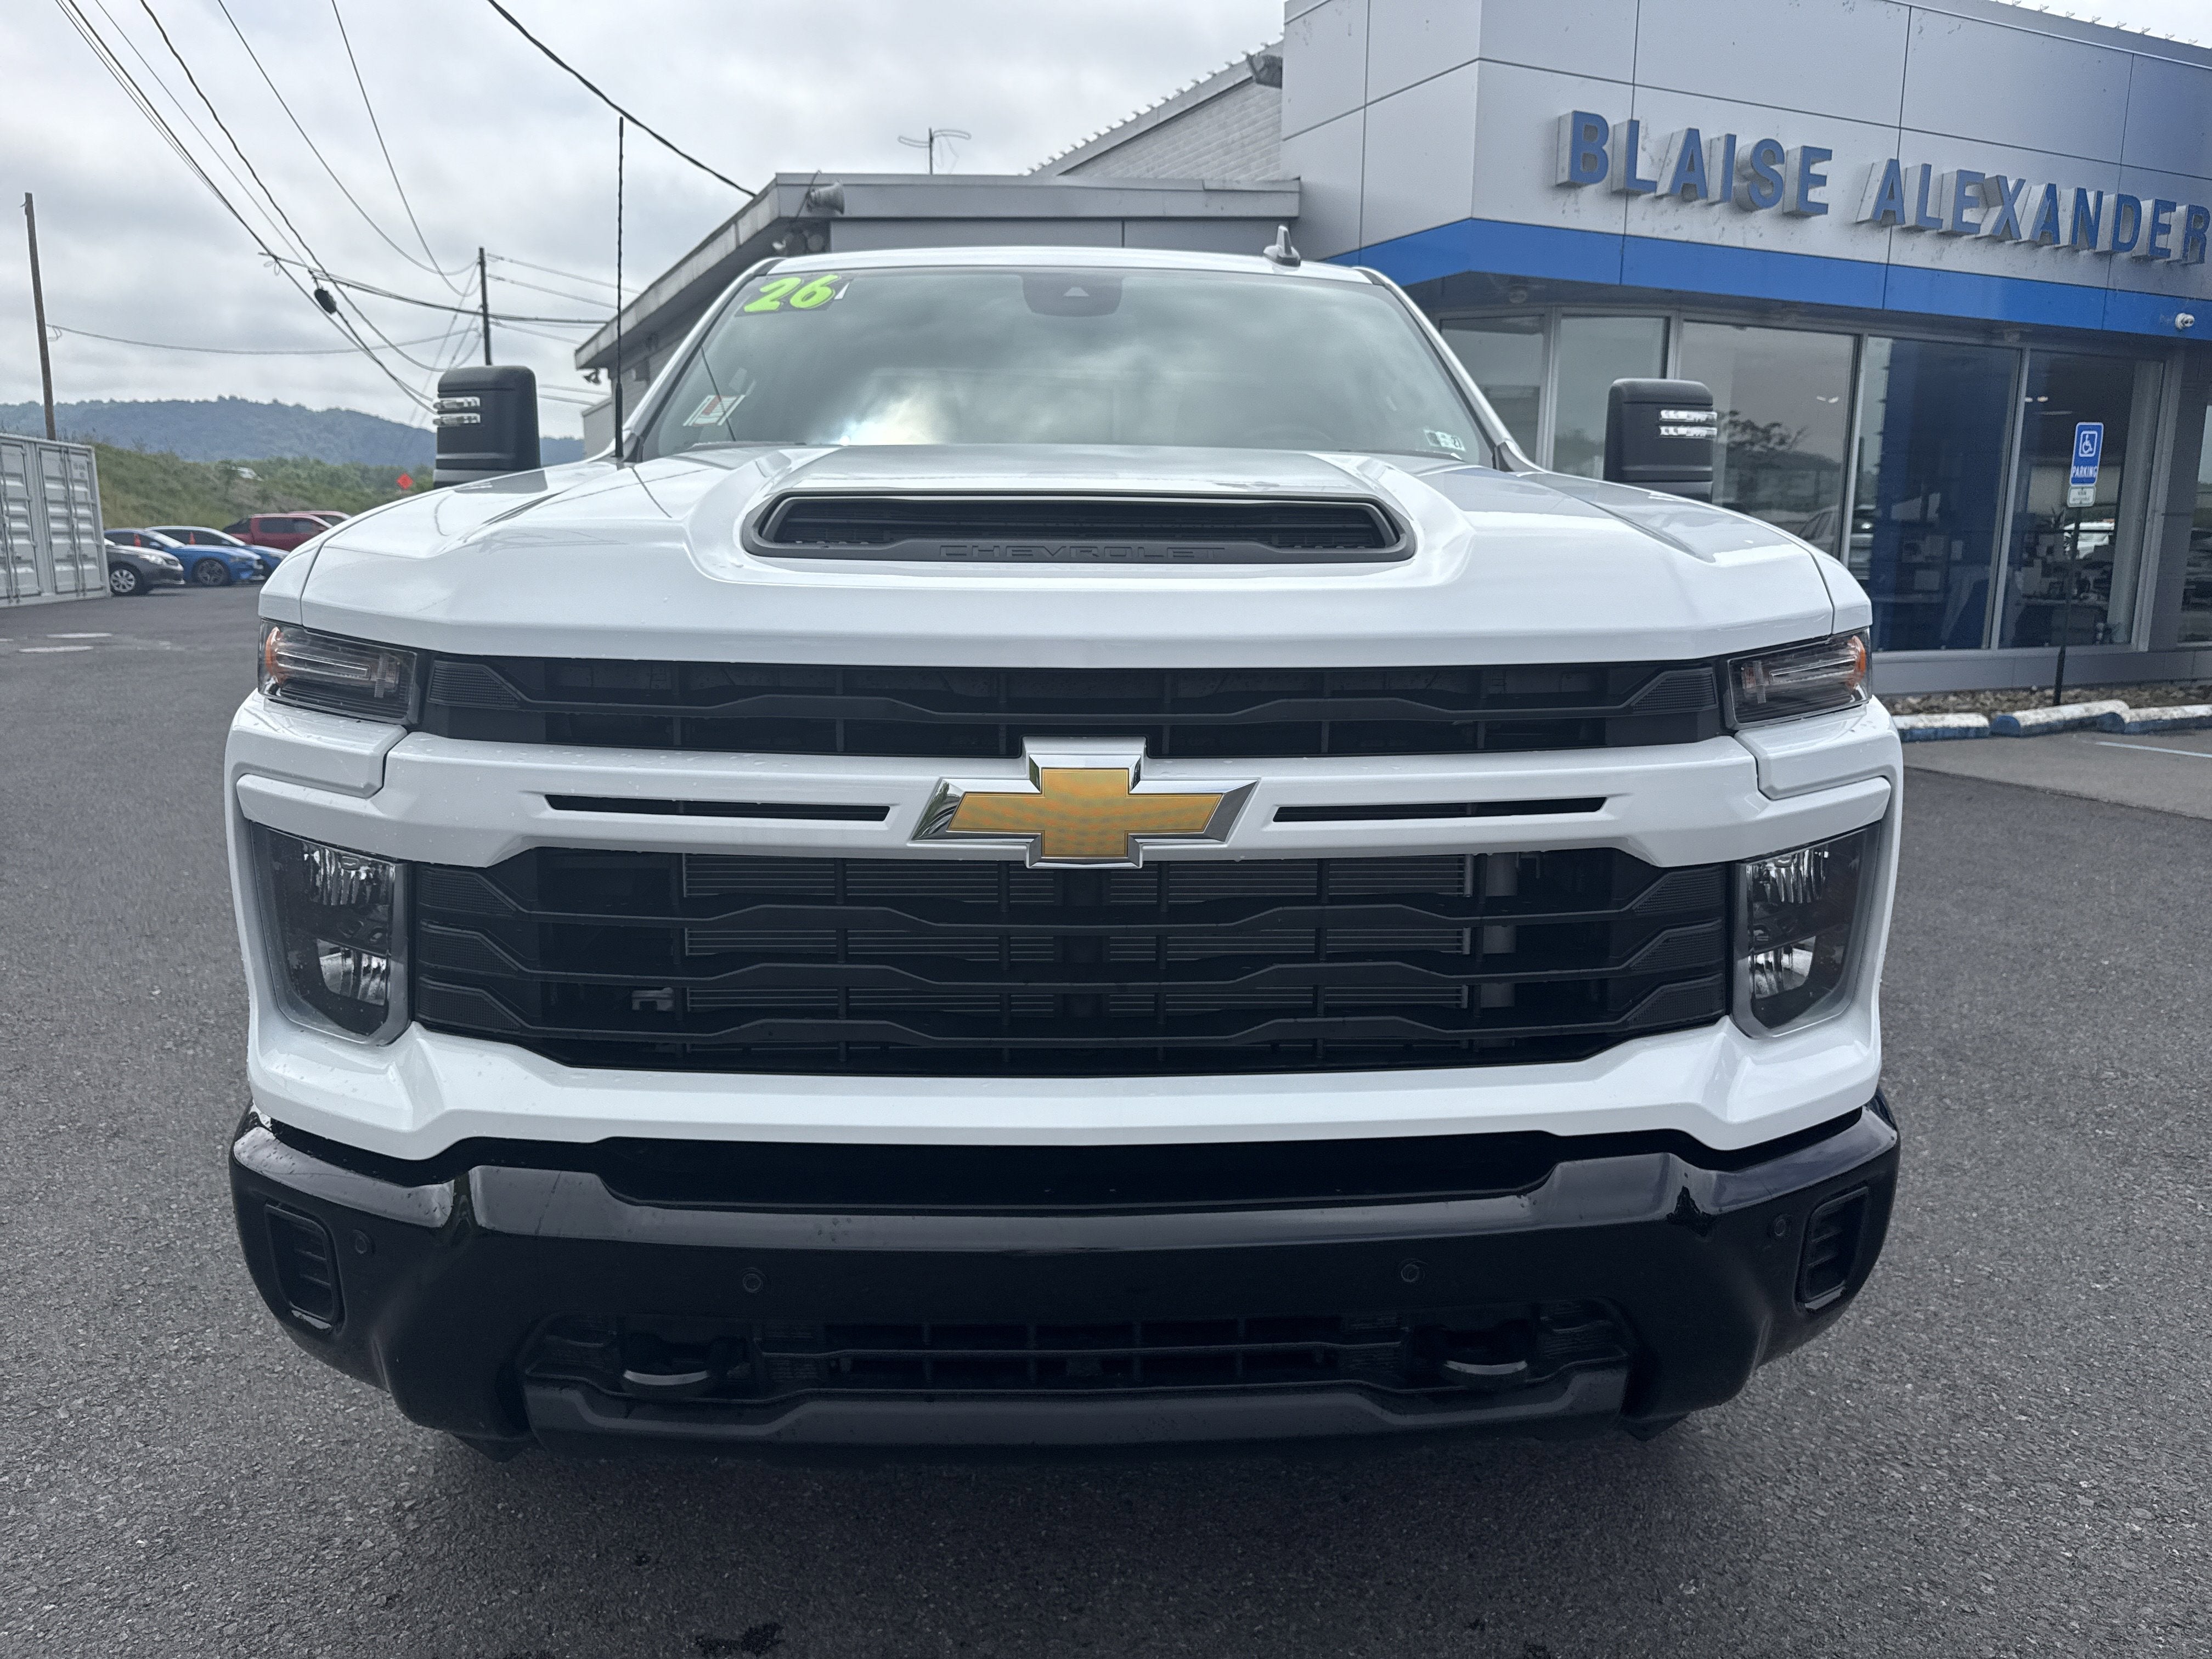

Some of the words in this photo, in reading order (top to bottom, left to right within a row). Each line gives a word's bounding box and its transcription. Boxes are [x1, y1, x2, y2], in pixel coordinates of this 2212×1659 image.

[1562, 110, 1832, 216] BLAISE
[1864, 159, 2211, 264] ALEXANDER
[743, 274, 840, 313] 26
[2071, 465, 2097, 478] PARKING
[940, 545, 1226, 559] CHEVROLET
